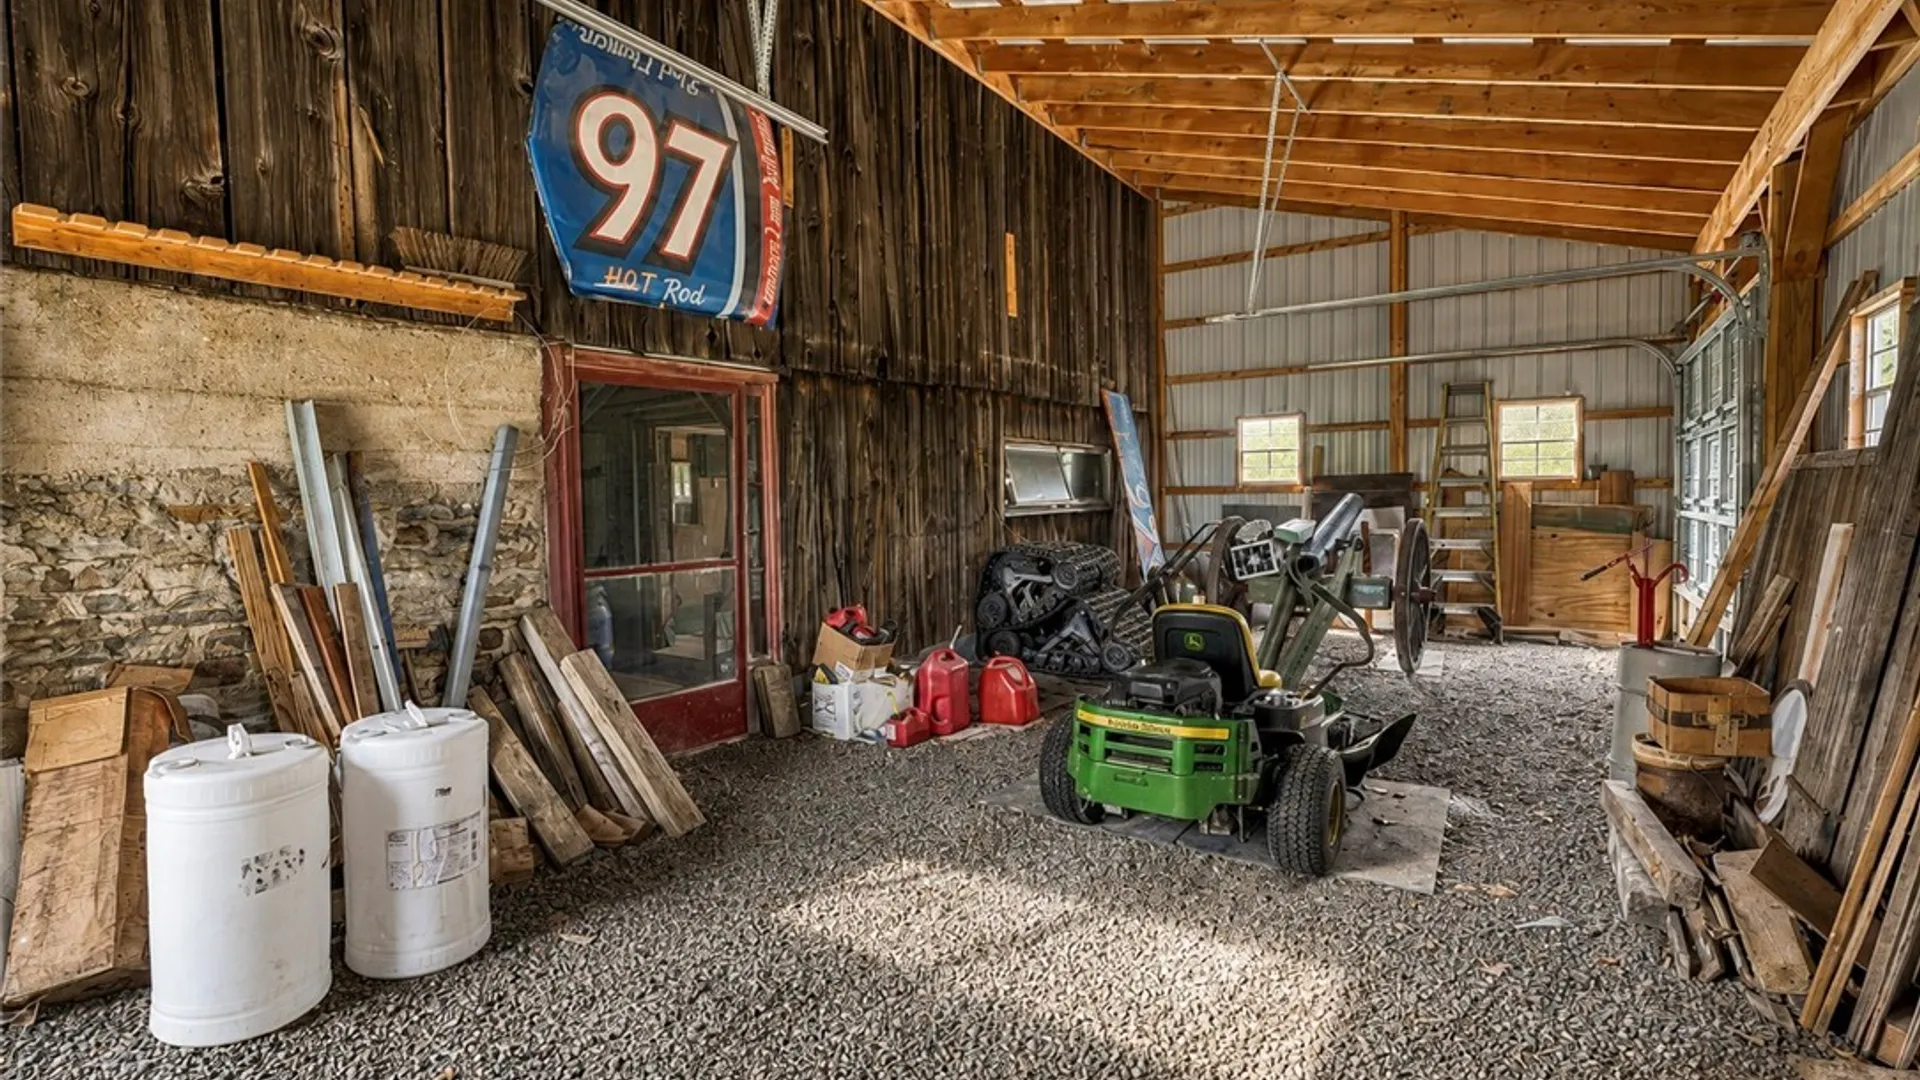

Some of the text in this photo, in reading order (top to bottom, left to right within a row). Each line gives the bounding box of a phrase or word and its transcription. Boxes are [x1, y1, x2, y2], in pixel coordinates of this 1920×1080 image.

[574, 89, 734, 263] 97
[603, 266, 706, 306] HOT Rod
